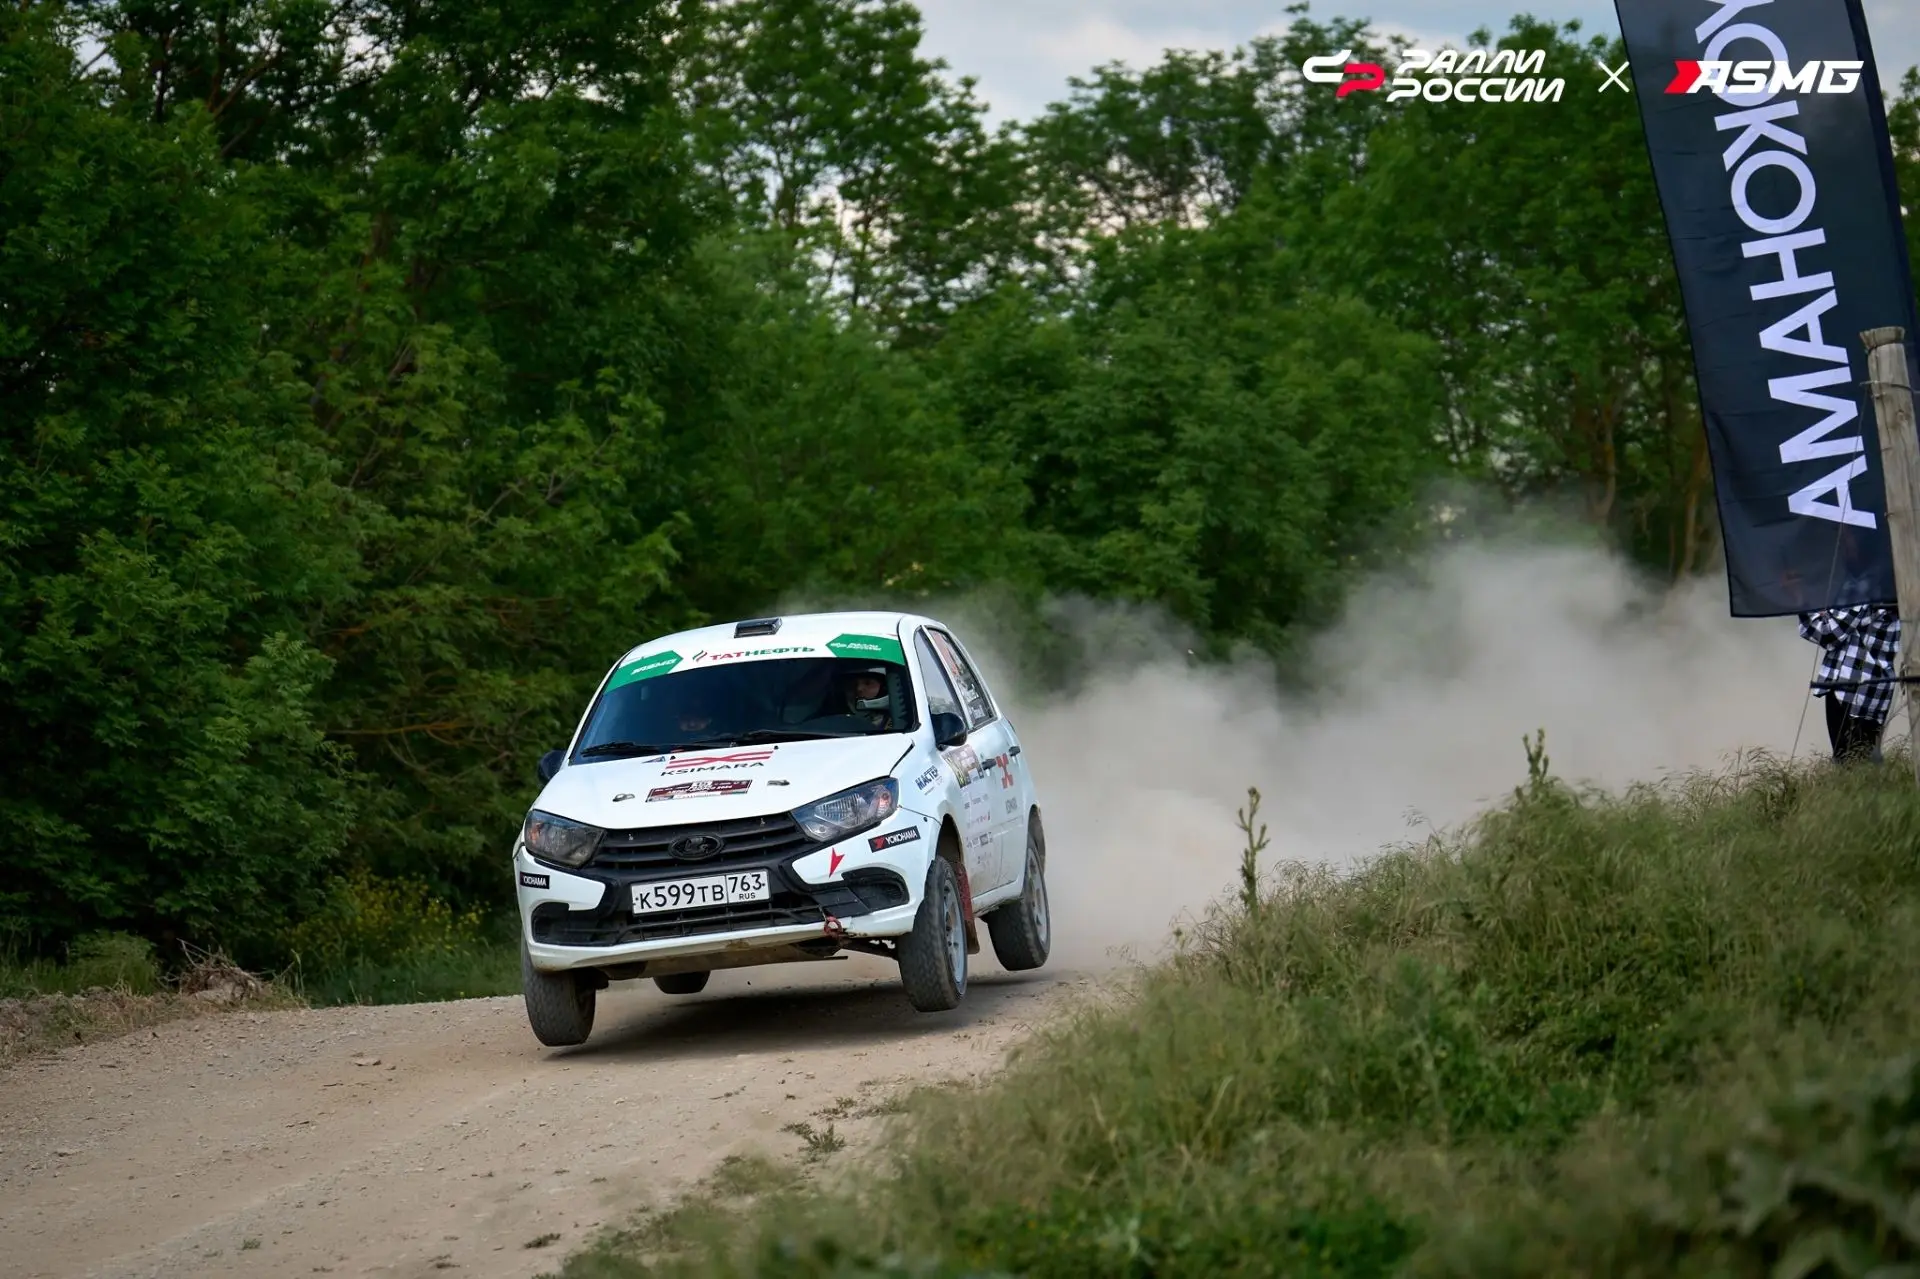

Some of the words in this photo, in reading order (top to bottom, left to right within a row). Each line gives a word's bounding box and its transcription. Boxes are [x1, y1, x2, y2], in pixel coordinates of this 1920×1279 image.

[709, 646, 816, 661] ТАТНЕФТЬ
[660, 762, 765, 776] KSIMARA
[885, 829, 918, 845] YOKOHAMA
[727, 873, 763, 894] 763
[739, 892, 757, 901] RUS
